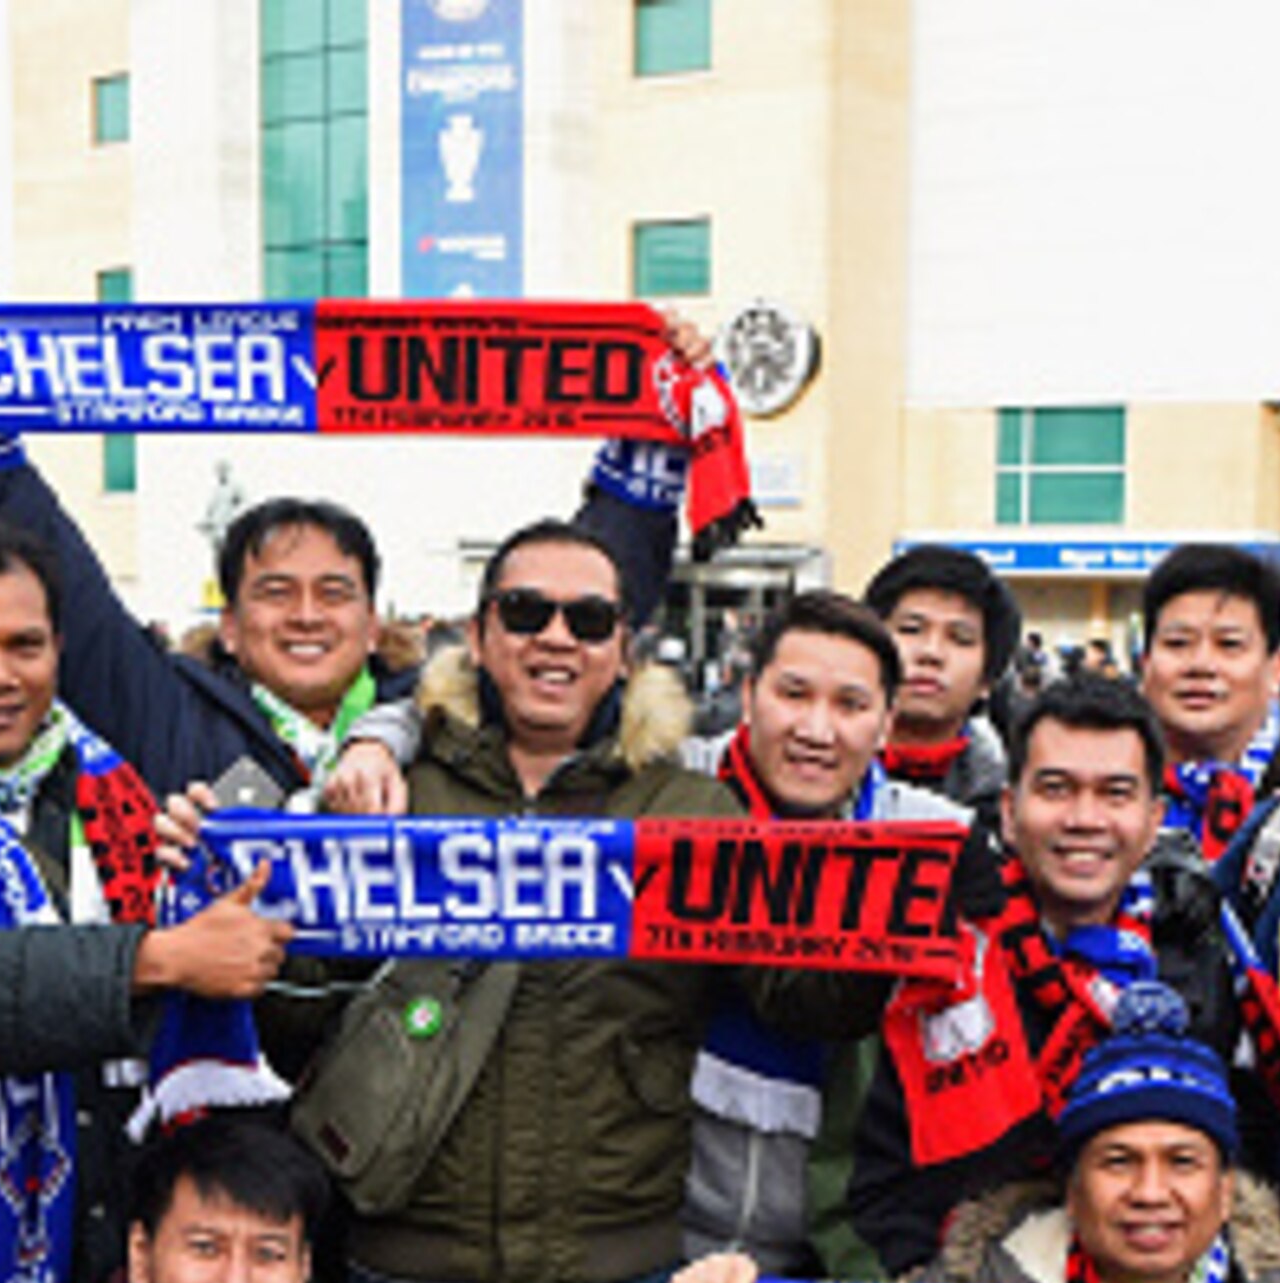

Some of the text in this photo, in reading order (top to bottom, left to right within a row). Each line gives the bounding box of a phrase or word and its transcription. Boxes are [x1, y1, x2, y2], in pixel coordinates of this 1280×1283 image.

[348, 335, 646, 405] UNITED
[231, 834, 596, 922] CHELSEA
[342, 923, 505, 950] STAMFORD
